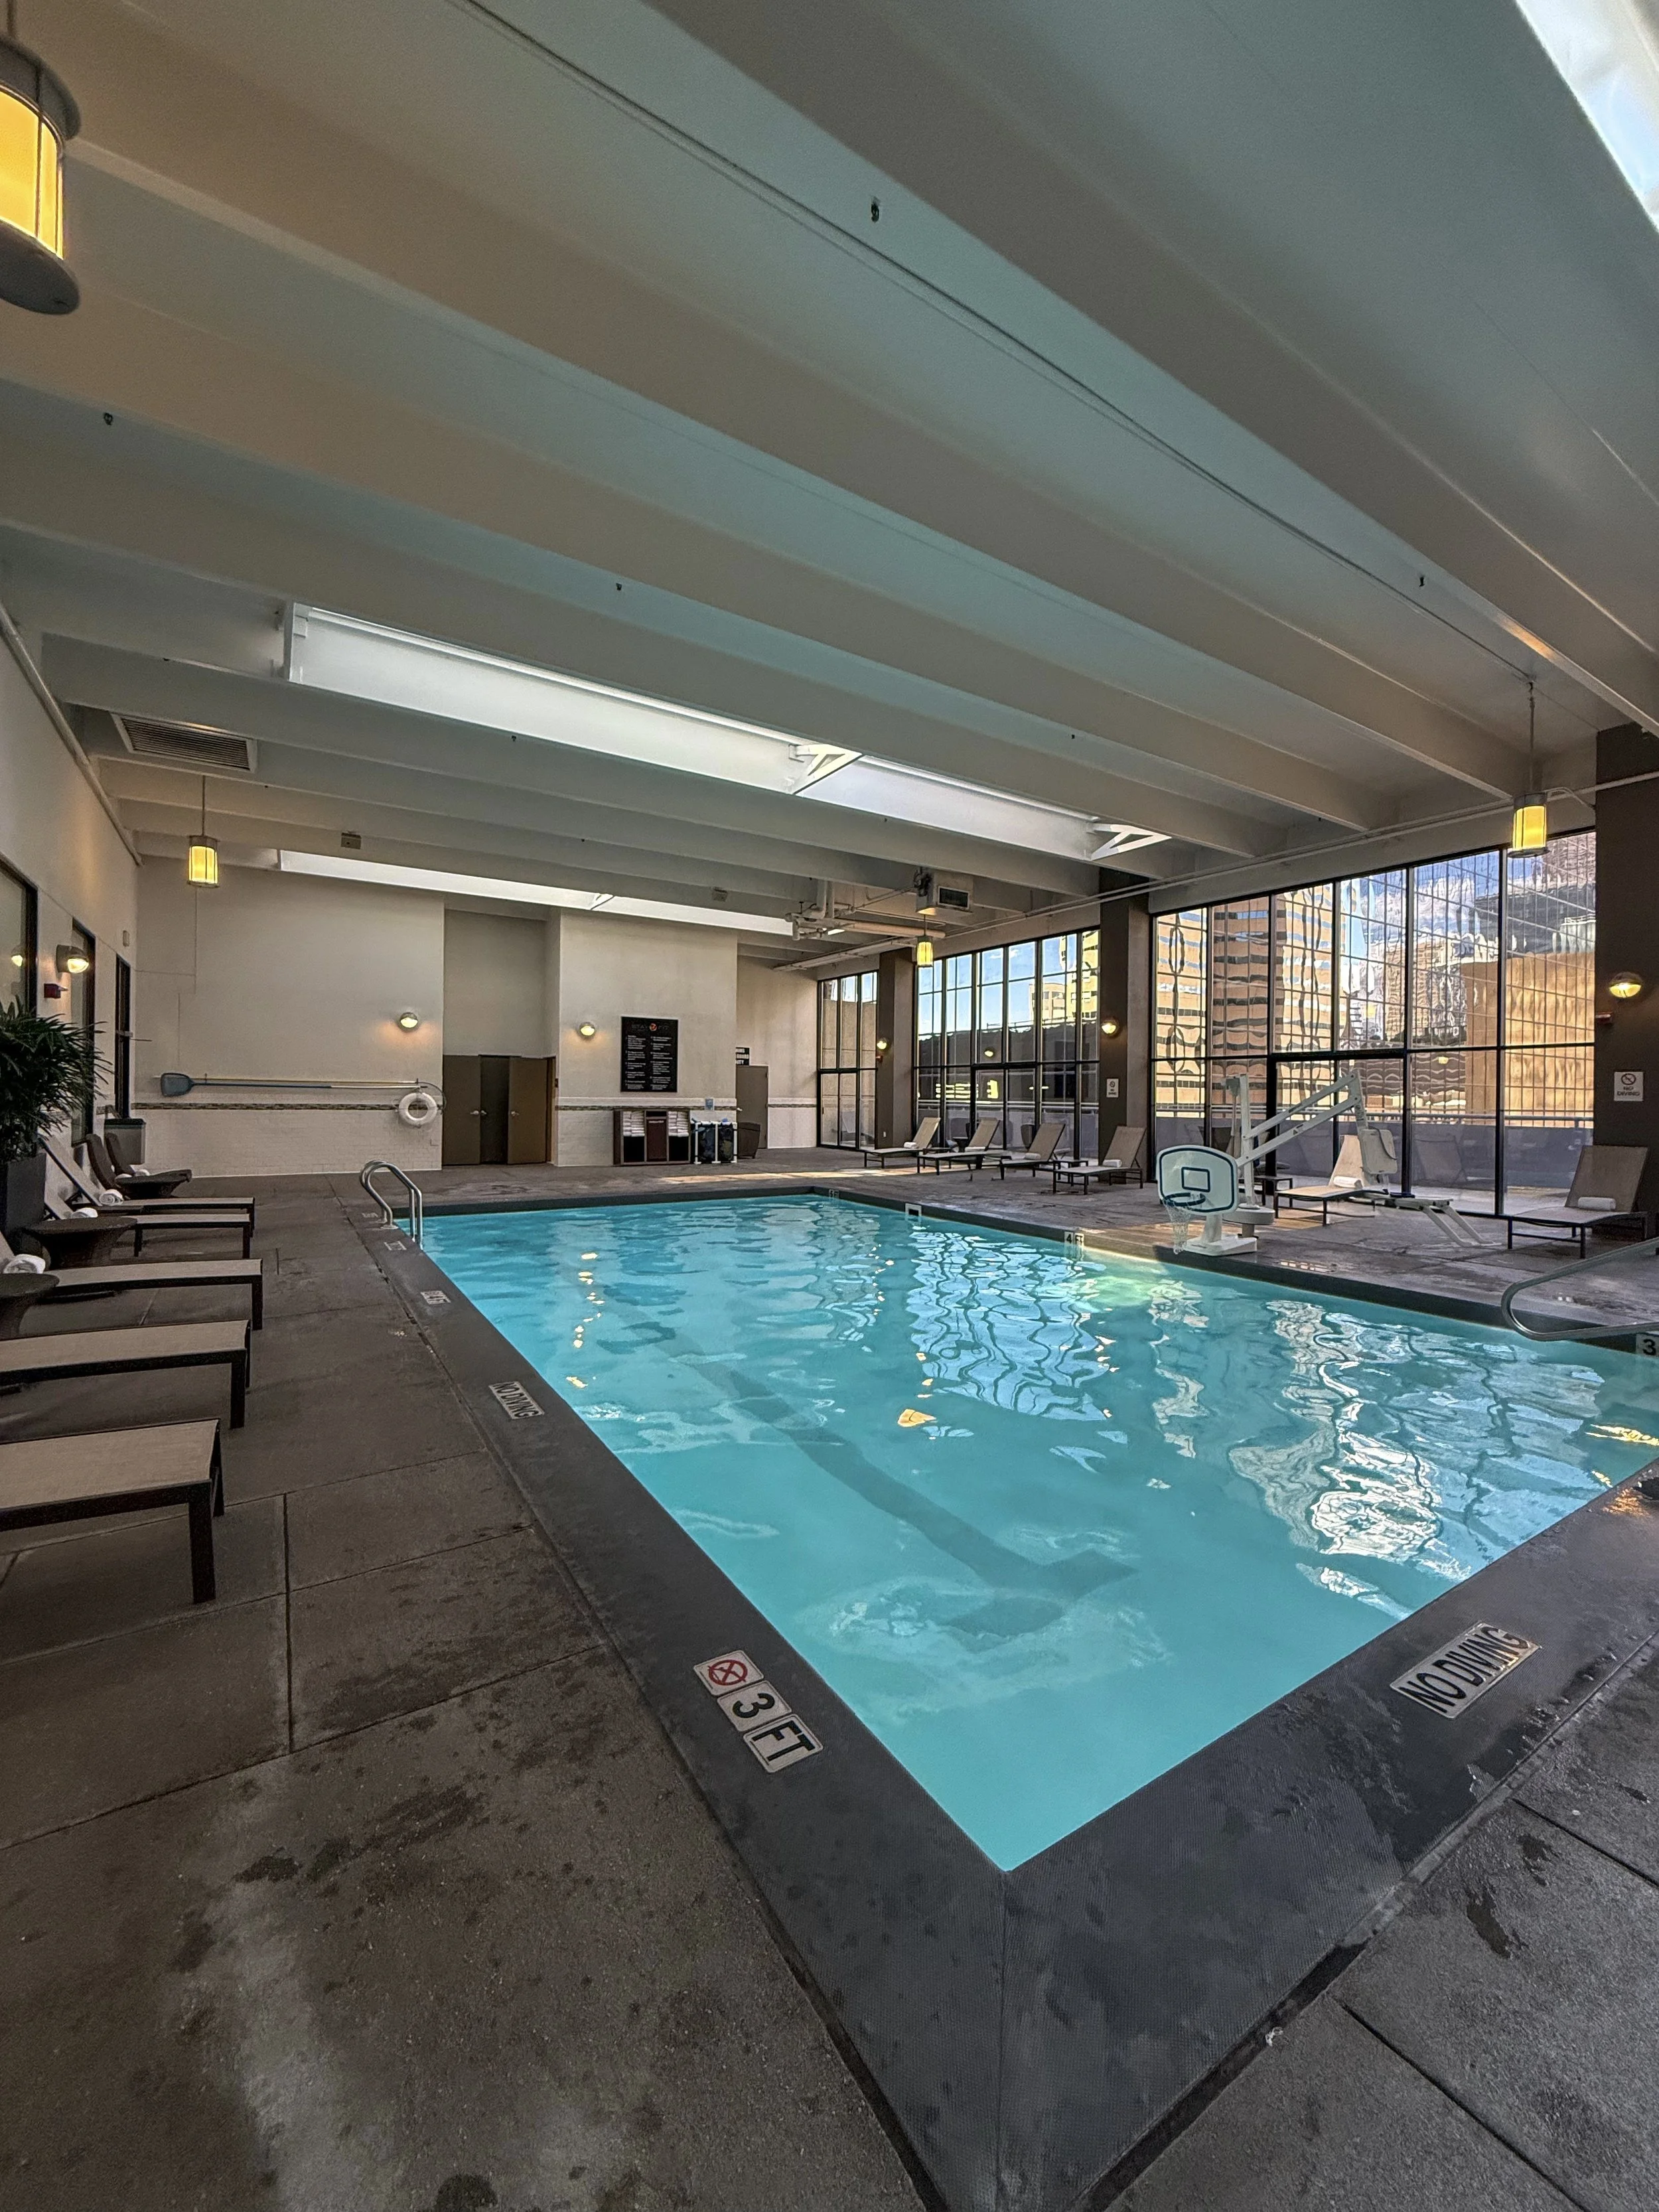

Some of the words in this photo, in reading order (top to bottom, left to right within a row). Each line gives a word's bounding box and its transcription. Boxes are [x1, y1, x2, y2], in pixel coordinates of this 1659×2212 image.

[1066, 1234, 1072, 1244] 4
[1075, 1234, 1083, 1245] FT
[1643, 1339, 1656, 1355] 3
[492, 1381, 520, 1394] NO
[501, 1393, 540, 1418] DIVING
[1432, 1626, 1529, 1687] DIVING
[732, 1692, 775, 1718] 3
[1398, 1672, 1467, 1714] NO
[751, 1720, 816, 1761] FT
